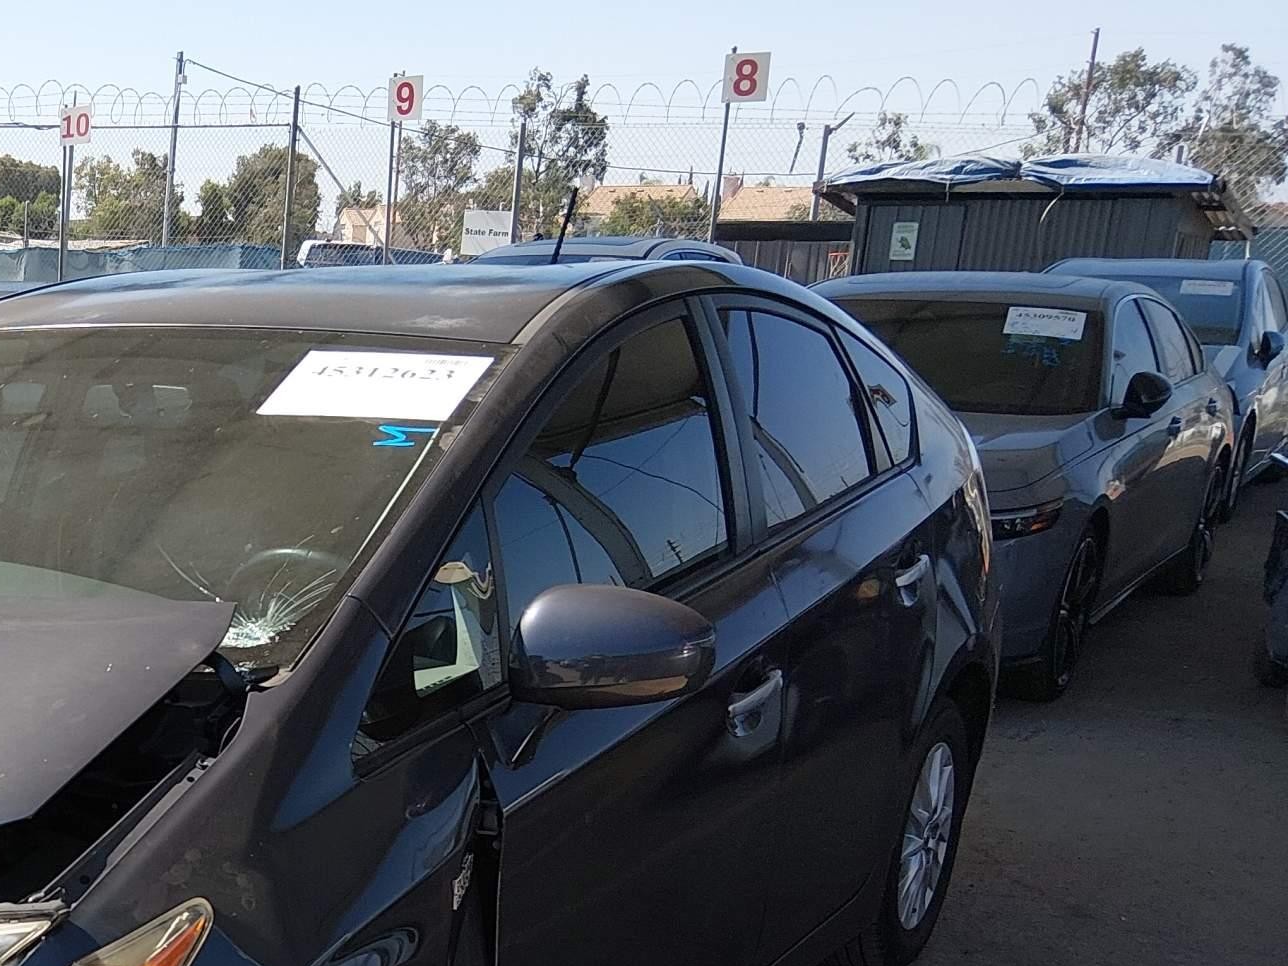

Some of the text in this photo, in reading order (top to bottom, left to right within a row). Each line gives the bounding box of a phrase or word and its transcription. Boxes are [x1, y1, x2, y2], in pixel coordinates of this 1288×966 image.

[733, 59, 758, 97] 8
[396, 81, 415, 116] 9
[62, 113, 90, 139] 10
[464, 227, 509, 238] State Farm
[312, 365, 455, 381] 45312623
